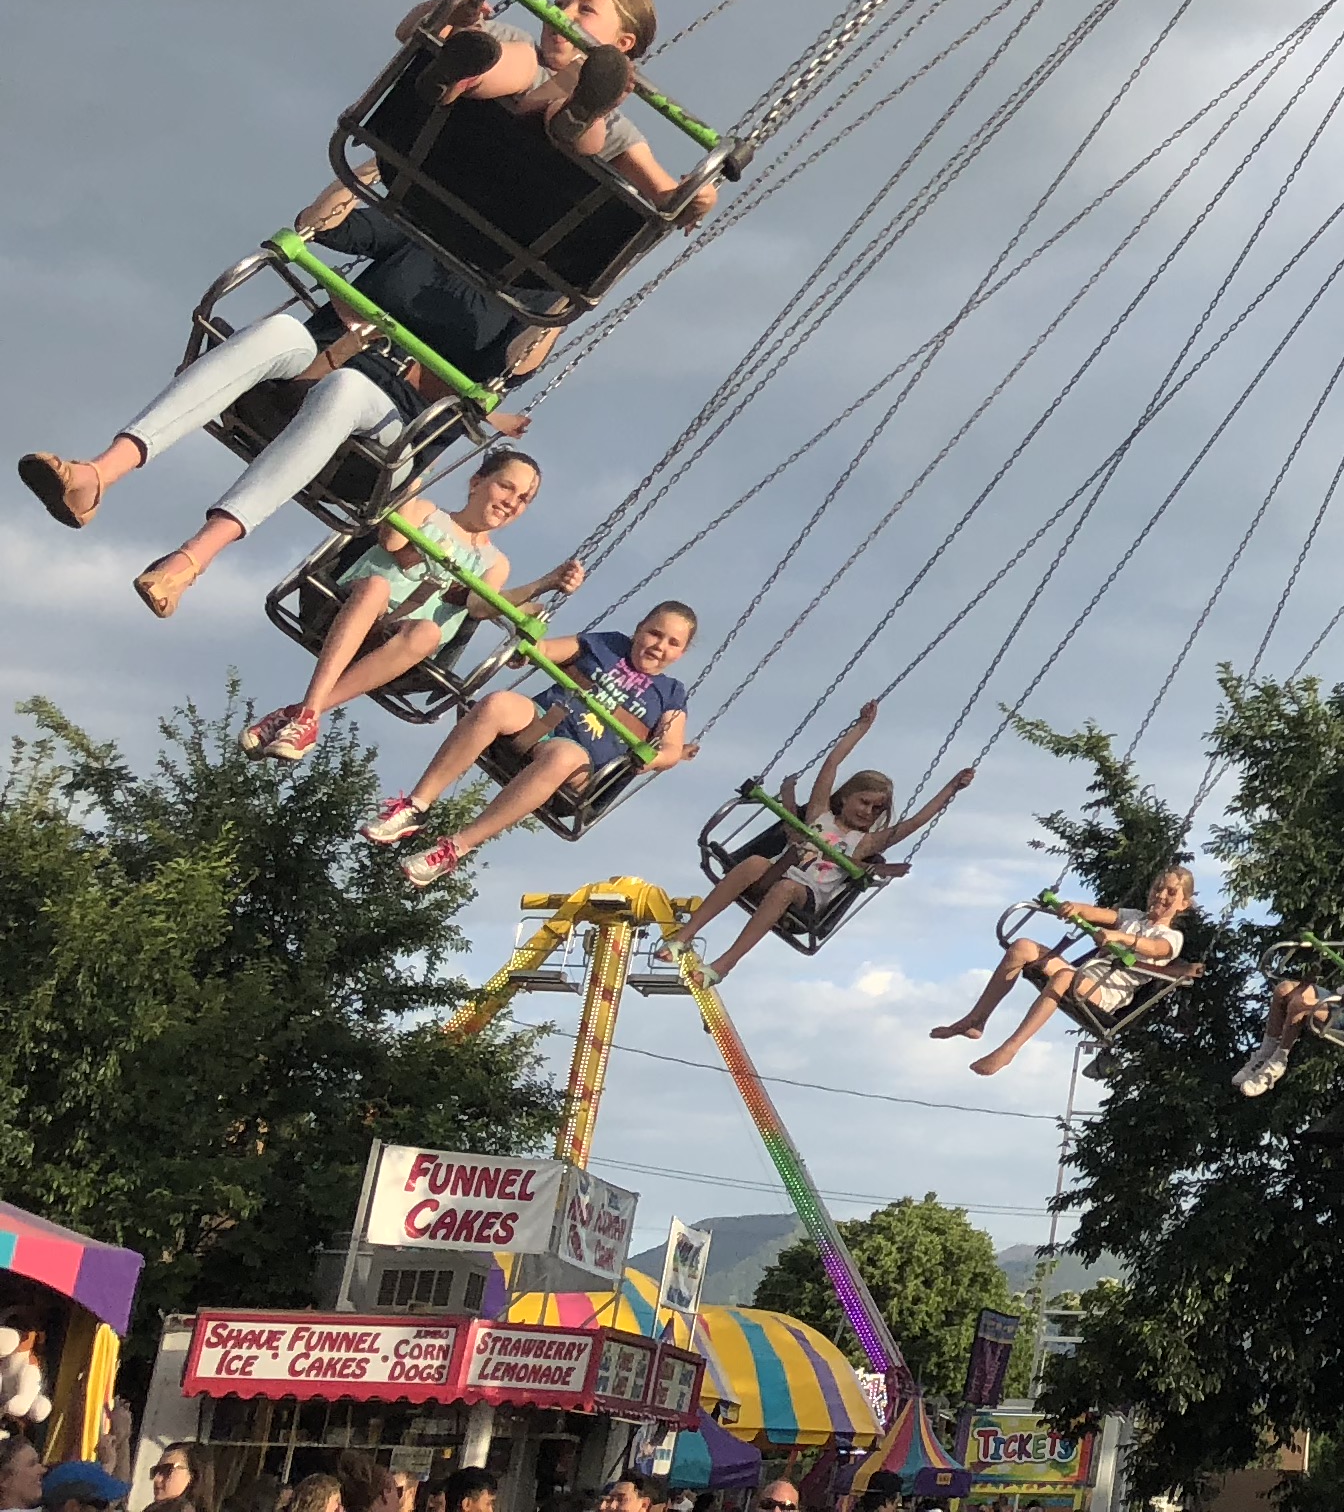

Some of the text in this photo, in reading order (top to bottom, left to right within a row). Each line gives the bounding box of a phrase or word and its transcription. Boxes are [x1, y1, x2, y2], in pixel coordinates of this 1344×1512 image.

[404, 1153, 536, 1201] FUNNEL
[404, 1199, 519, 1245] CAKES
[205, 1322, 288, 1351] SHAVE
[287, 1326, 381, 1354] FUNNEL
[393, 1340, 450, 1361] CORN
[476, 1331, 589, 1362] STRAWBERRY
[215, 1350, 447, 1383] ICE CAKES DOGS
[477, 1358, 576, 1386] LEMONADE
[976, 1428, 1077, 1460] TICKETS
